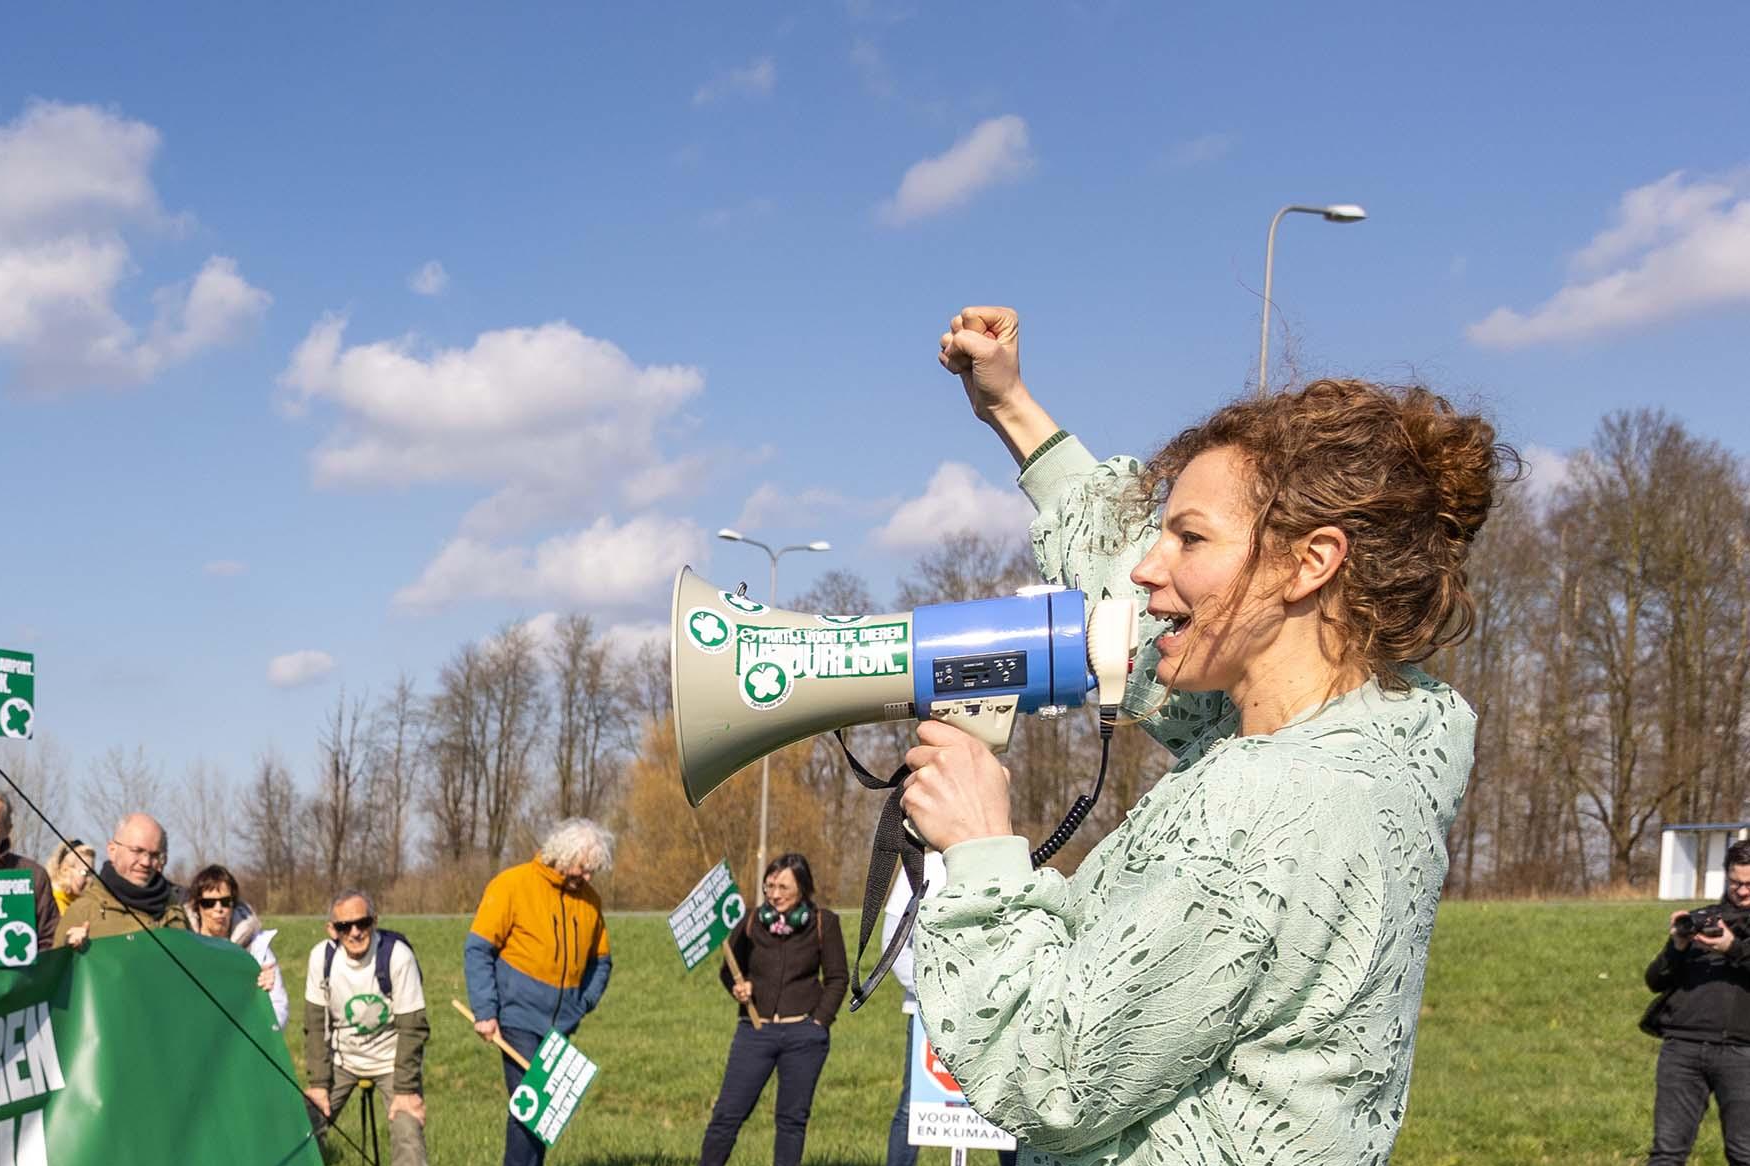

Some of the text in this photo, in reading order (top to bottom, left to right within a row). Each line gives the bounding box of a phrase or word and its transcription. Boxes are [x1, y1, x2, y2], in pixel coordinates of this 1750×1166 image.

[842, 629, 857, 643] DE
[859, 626, 904, 642] DIEREN
[917, 1112, 961, 1124] VOOR
[917, 1126, 937, 1136] EN
